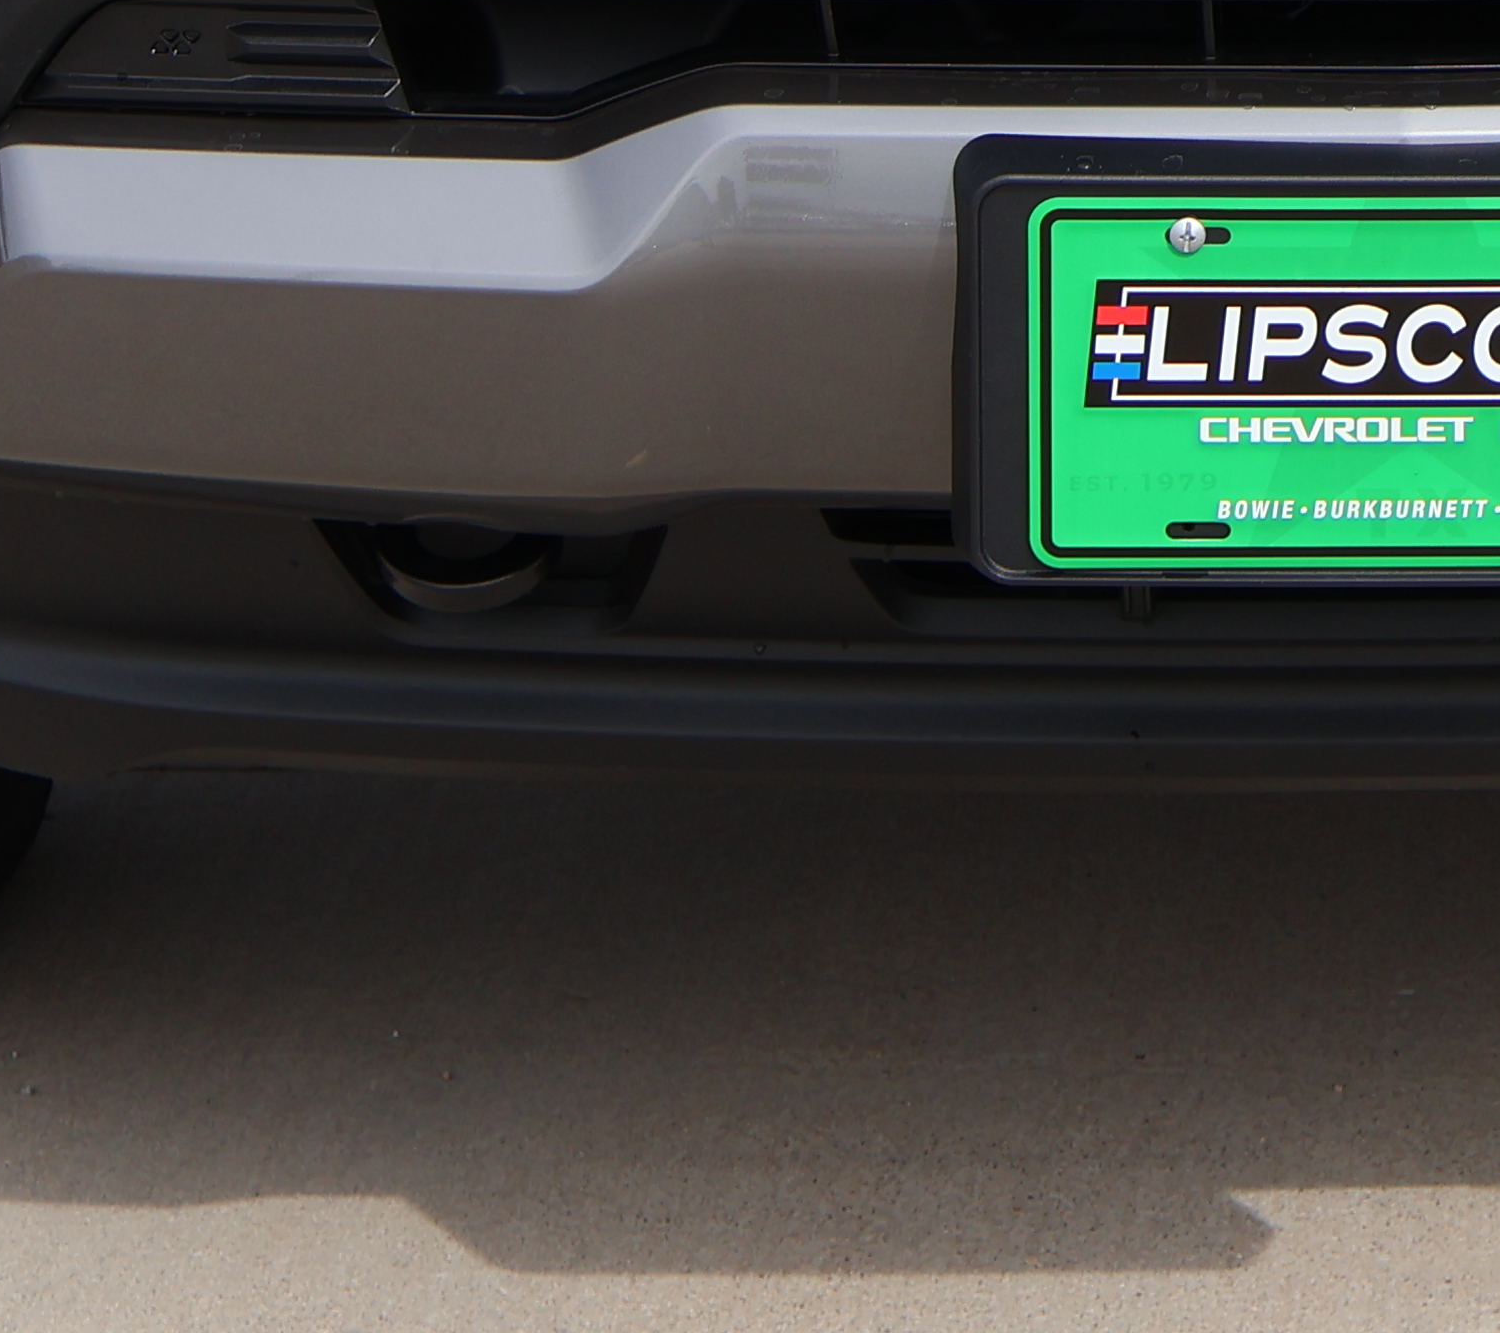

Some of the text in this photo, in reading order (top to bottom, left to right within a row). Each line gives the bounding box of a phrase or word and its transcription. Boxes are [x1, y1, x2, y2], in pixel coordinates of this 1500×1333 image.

[1198, 416, 1474, 444] CHEVROLET
[1068, 472, 1219, 493] EST. 1979
[1216, 499, 1296, 521] BOWIE
[1312, 498, 1490, 520] BURKBURNETT
